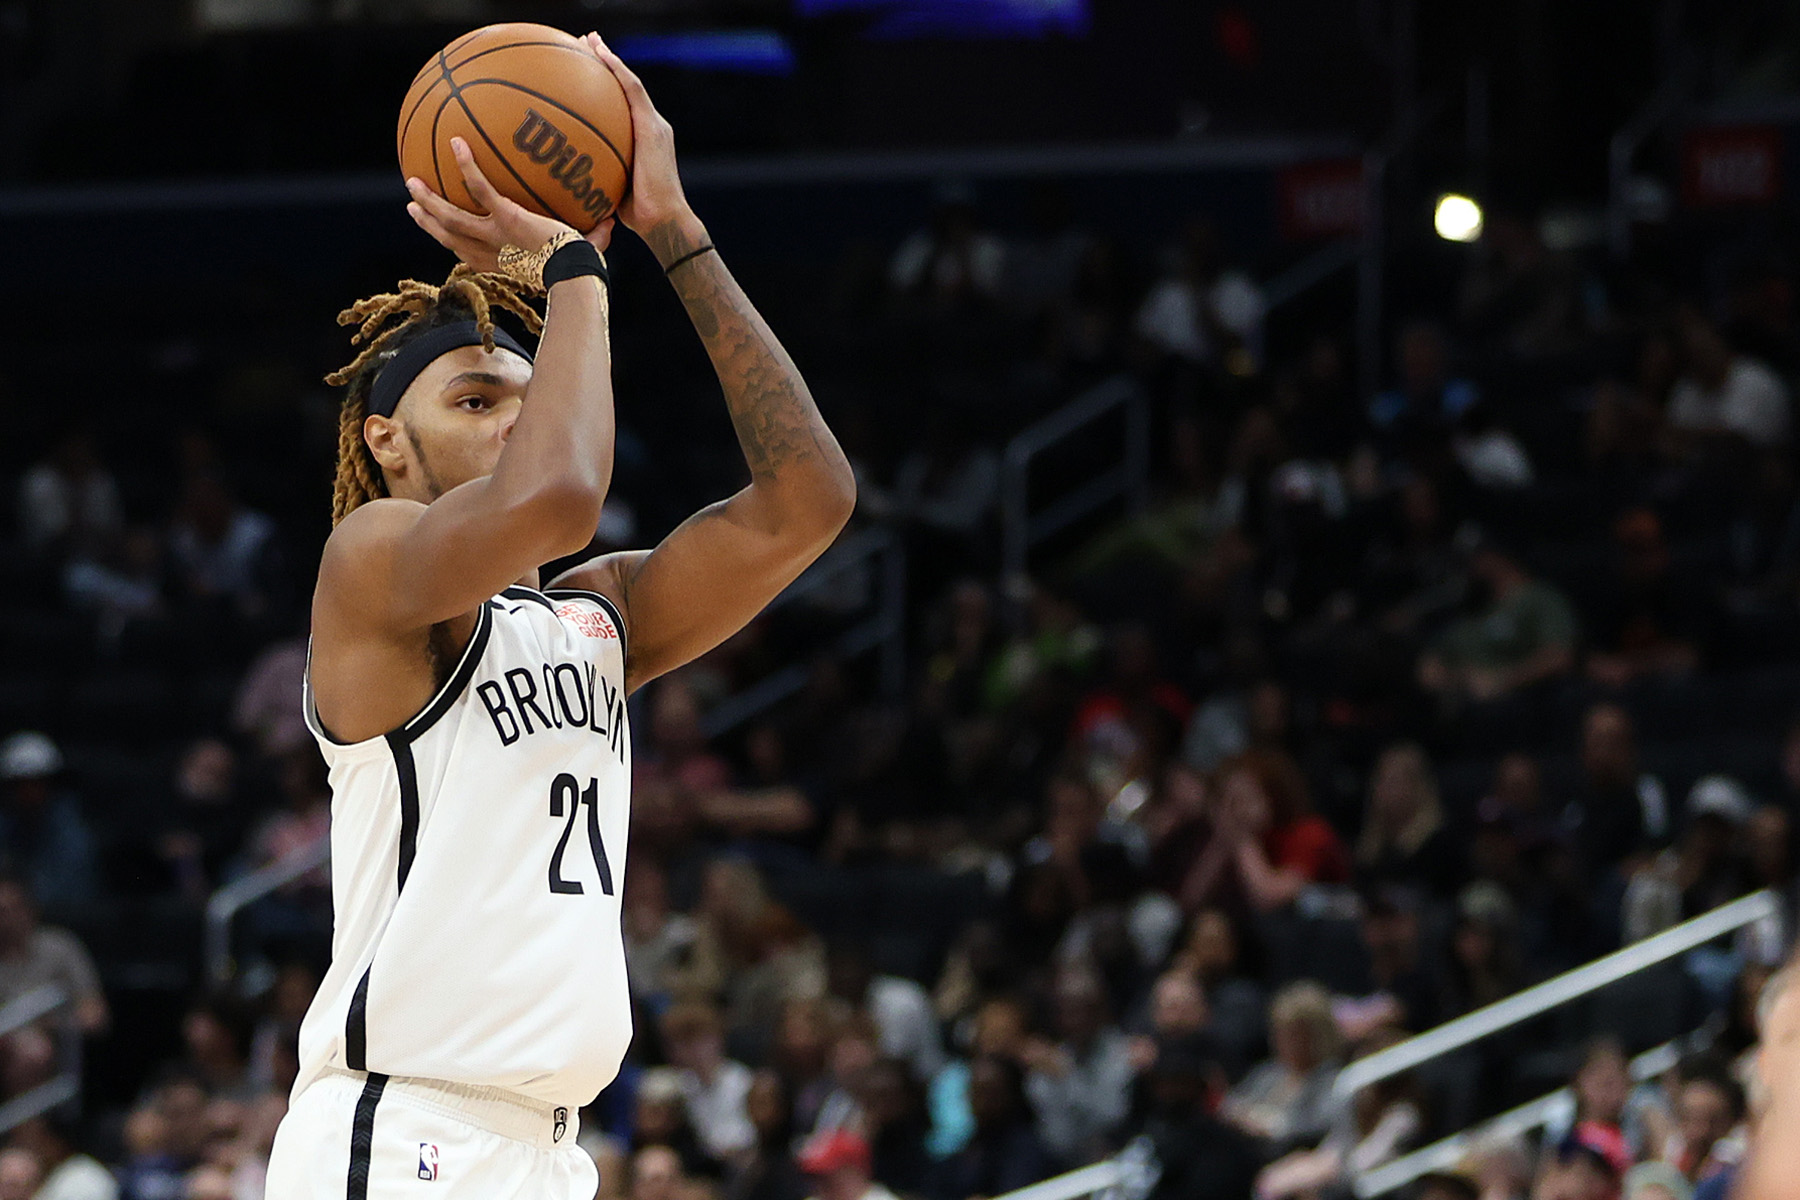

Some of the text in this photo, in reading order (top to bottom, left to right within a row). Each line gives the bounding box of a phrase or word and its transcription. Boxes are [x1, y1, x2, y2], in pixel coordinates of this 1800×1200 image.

[512, 107, 614, 223] Wilson
[555, 603, 583, 618] GET
[565, 611, 607, 626] YOUR
[578, 624, 617, 640] GUDE
[547, 772, 615, 897] 21
